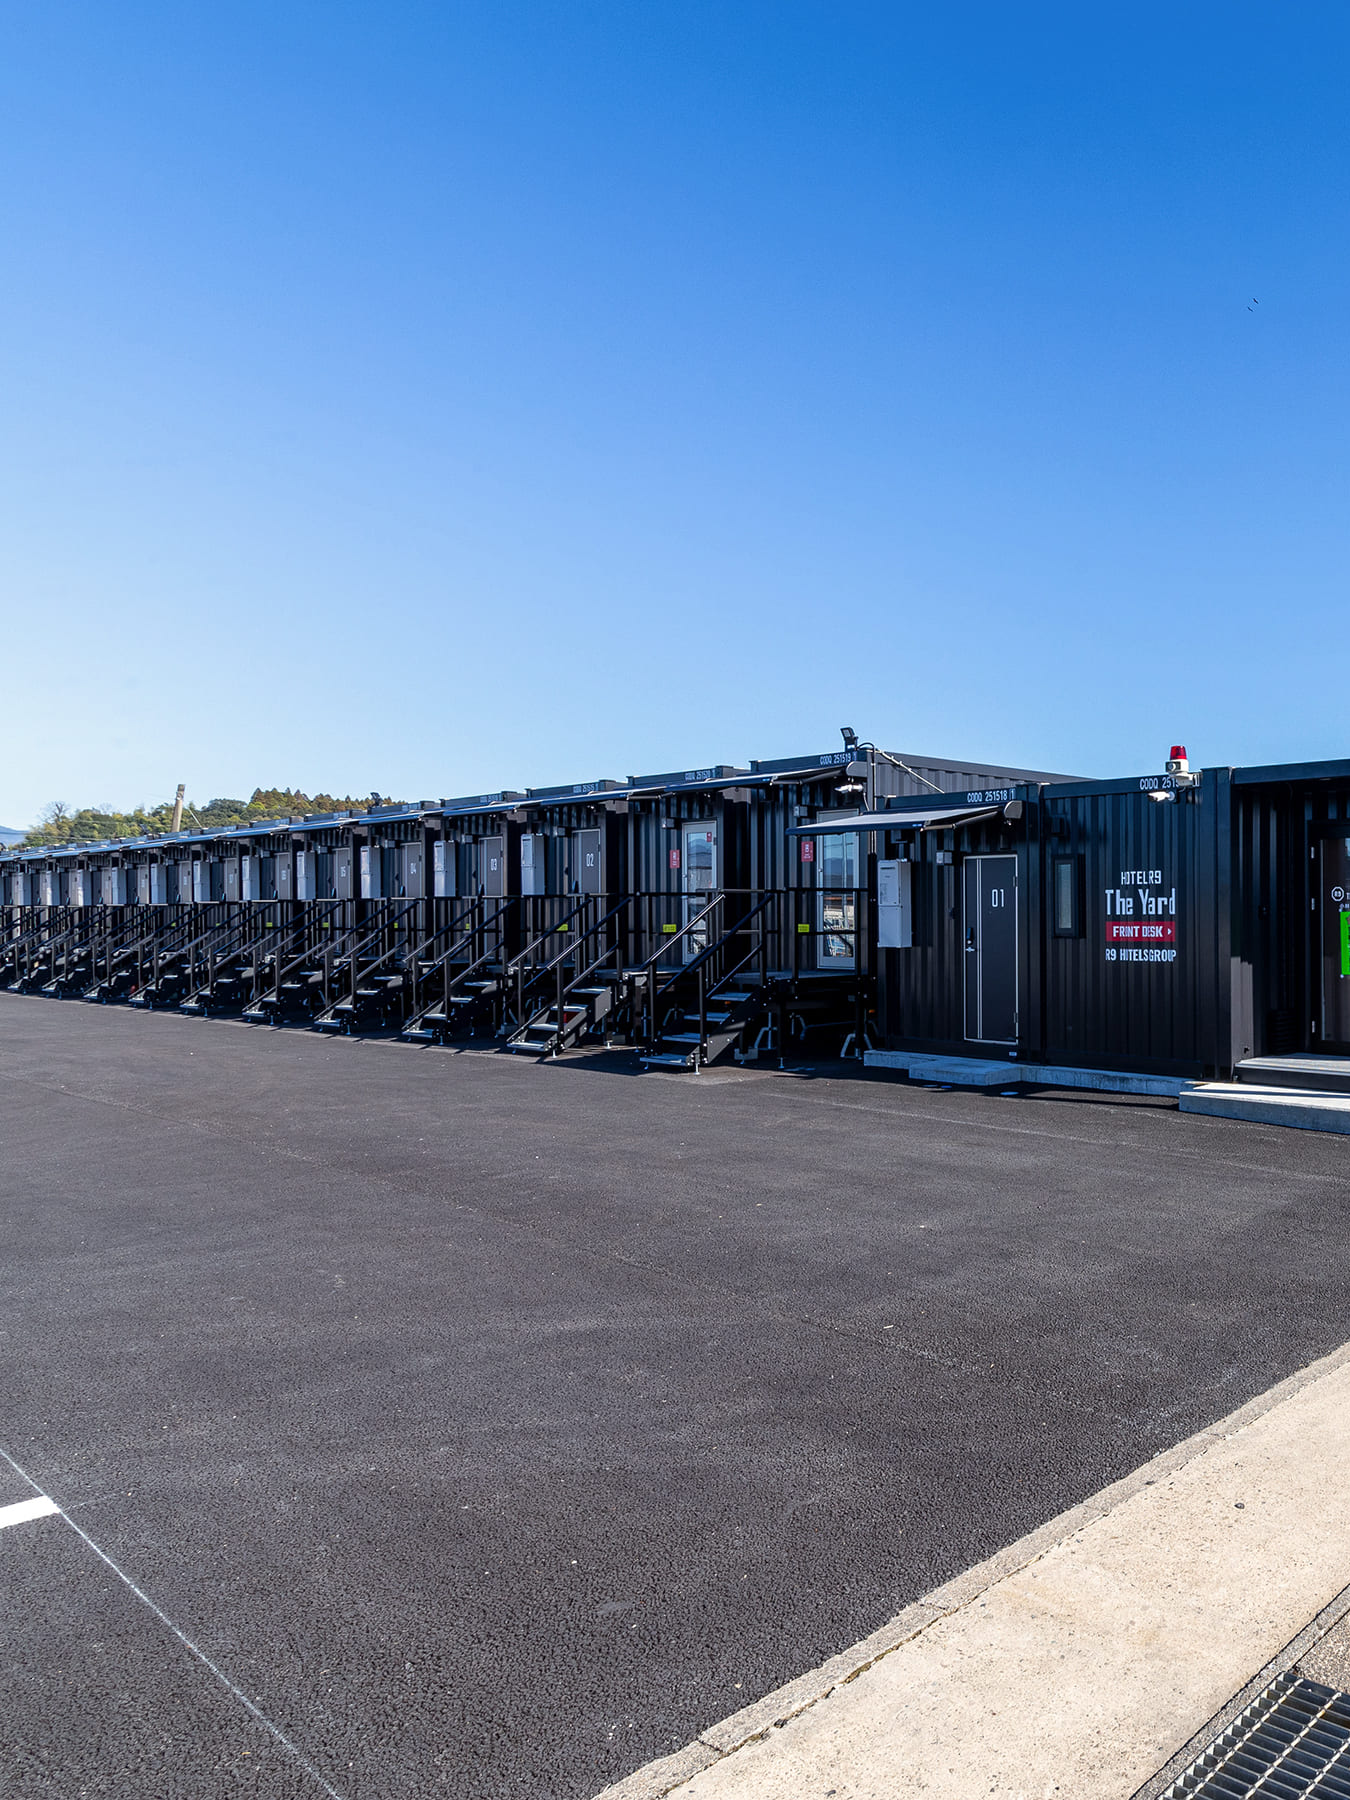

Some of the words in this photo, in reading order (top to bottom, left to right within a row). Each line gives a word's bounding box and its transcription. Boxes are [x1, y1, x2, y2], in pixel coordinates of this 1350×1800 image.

[985, 790, 1007, 801] 251518
[586, 853, 594, 867] 02
[991, 889, 1005, 908] 01
[1105, 889, 1134, 915] The
[1138, 887, 1176, 915] Yard
[1142, 925, 1164, 938] DESK
[1105, 948, 1117, 961] R9
[1119, 948, 1149, 962] HTELS
